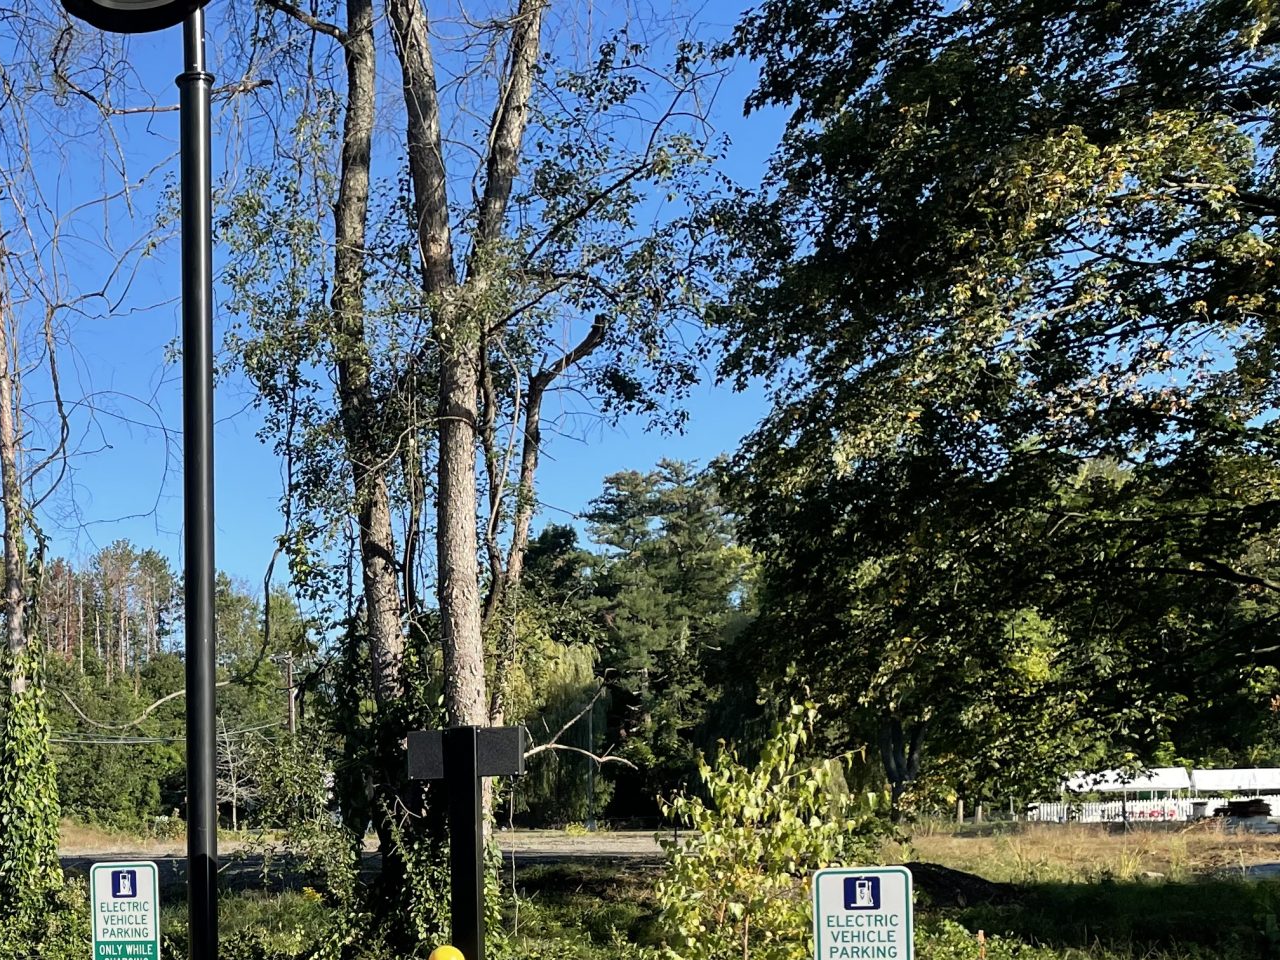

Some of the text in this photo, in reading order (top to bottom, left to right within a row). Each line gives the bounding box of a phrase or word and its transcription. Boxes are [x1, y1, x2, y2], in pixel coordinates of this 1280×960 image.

[101, 901, 149, 912] ELECTRIC
[103, 915, 147, 925] VEHICLE
[827, 914, 899, 927] ELECTRIC
[102, 928, 149, 938] PARKING
[831, 930, 896, 942] VEHICLE
[100, 944, 153, 955] ONLY WHILE
[830, 946, 897, 958] PARKING
